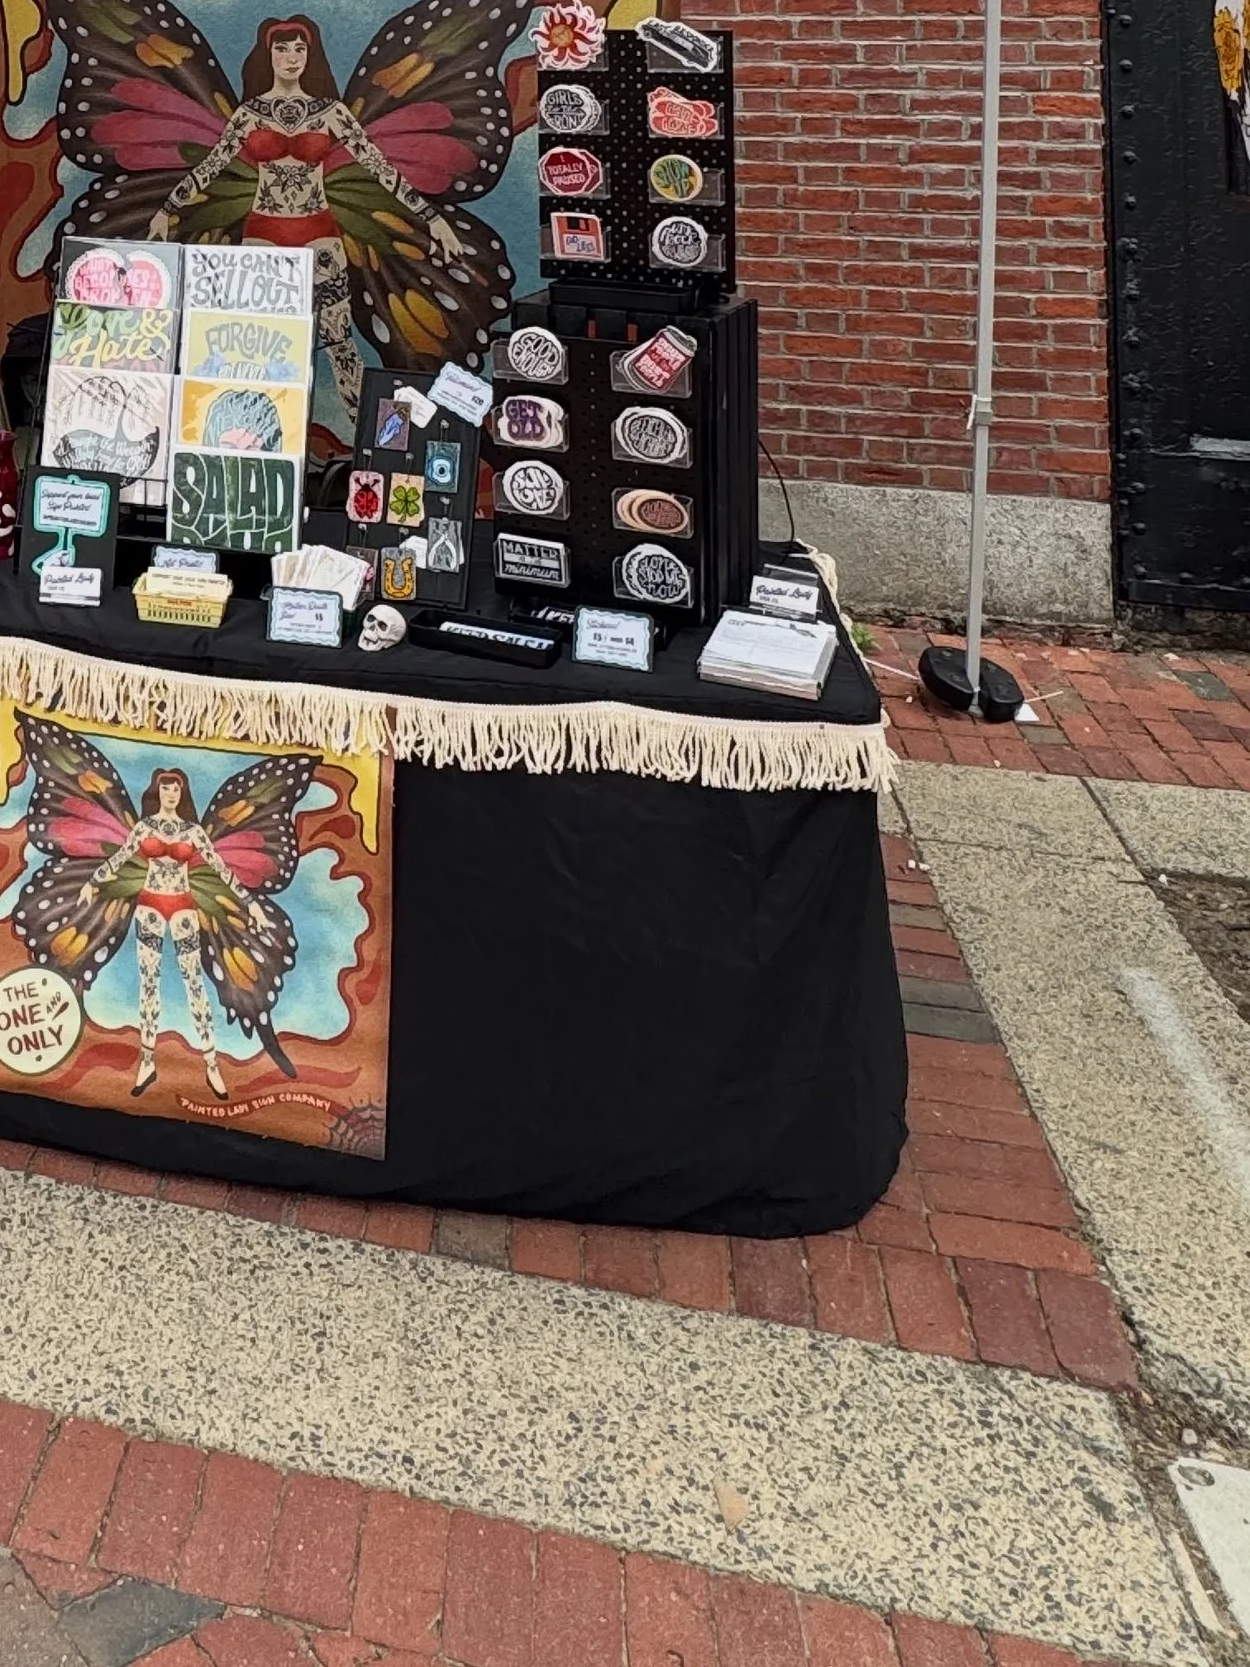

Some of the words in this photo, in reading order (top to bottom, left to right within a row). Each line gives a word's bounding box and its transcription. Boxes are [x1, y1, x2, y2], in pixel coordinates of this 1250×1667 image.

[547, 90, 582, 105] GIRLS
[192, 249, 237, 277] YOU
[204, 321, 293, 365] FORGIVE
[520, 333, 558, 365] GOOD
[506, 400, 543, 420] GET
[508, 419, 545, 442] OLD
[171, 452, 295, 537] SALAD
[502, 541, 559, 560] MATTER
[505, 563, 559, 580] minimum
[2, 981, 39, 1002] THE
[46, 991, 62, 1014] AND
[7, 1024, 63, 1055] ONLY
[180, 1097, 225, 1117] PAINTED
[227, 1103, 249, 1117] LADY
[279, 1093, 331, 1112] COMPANY
